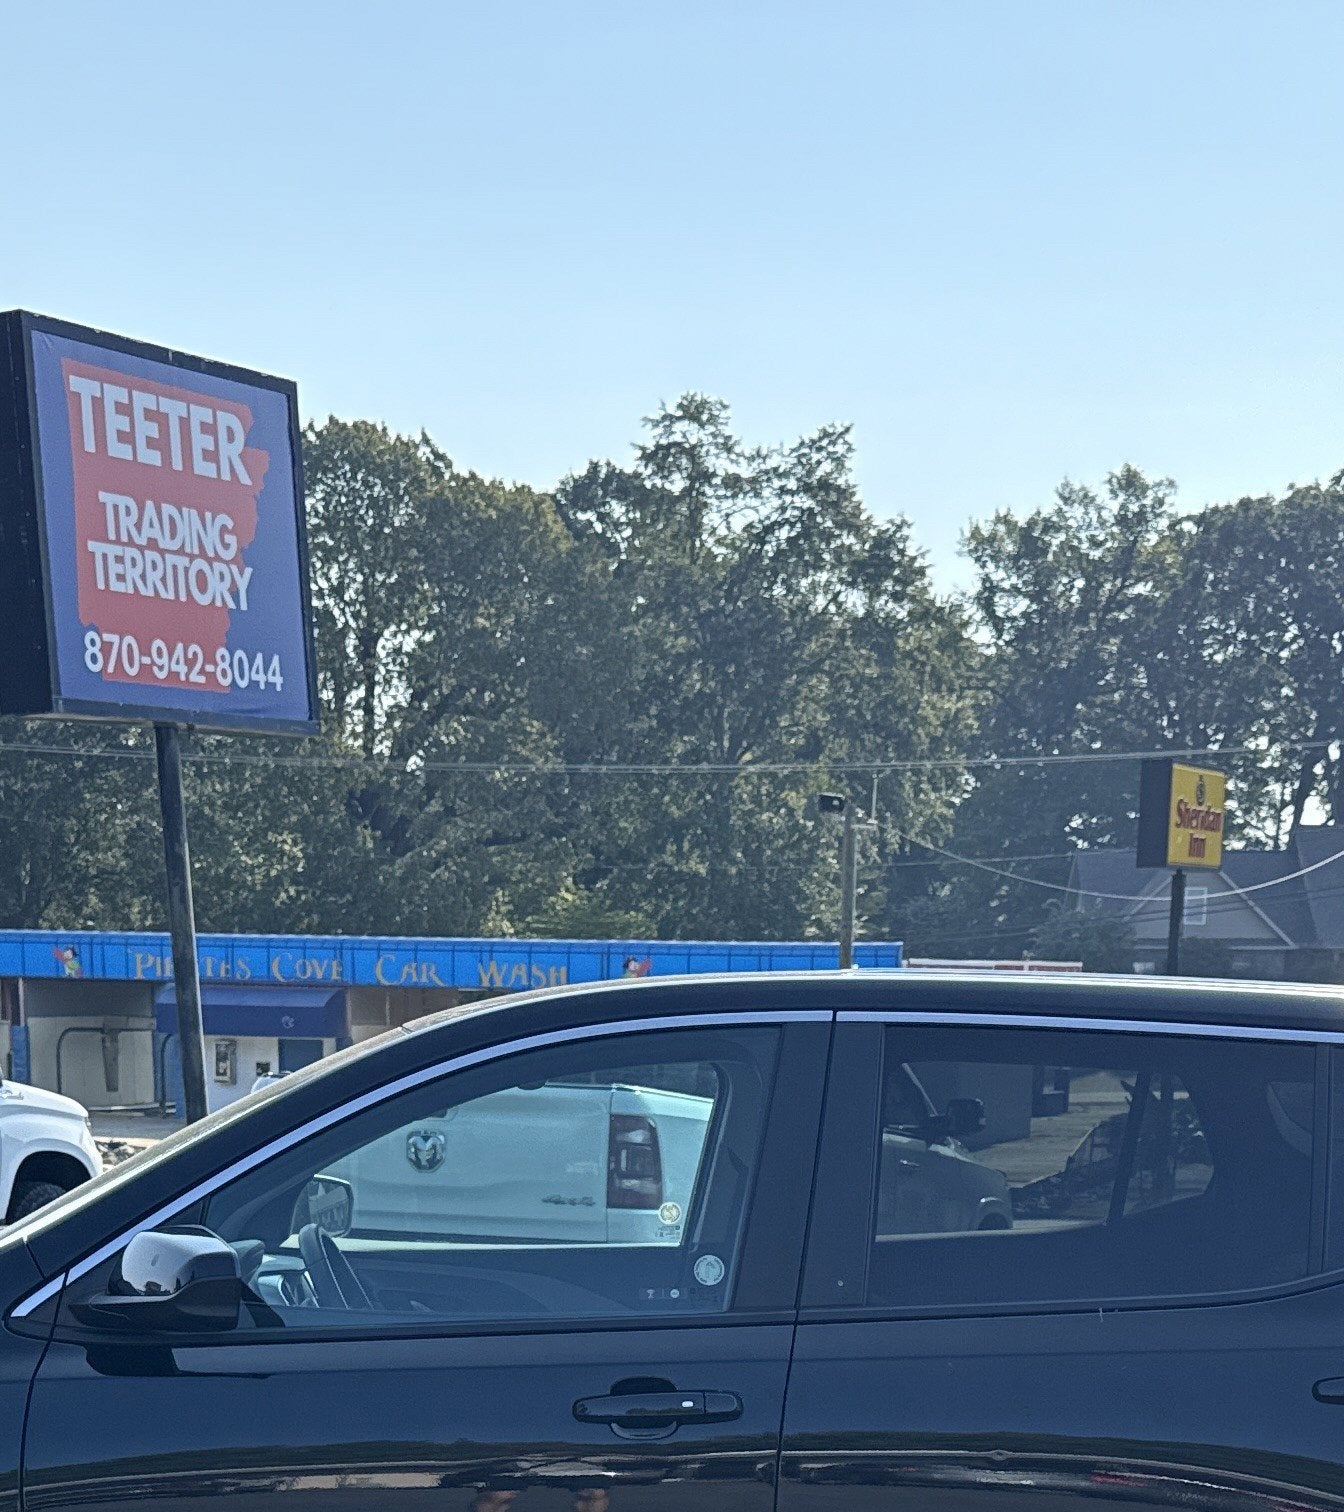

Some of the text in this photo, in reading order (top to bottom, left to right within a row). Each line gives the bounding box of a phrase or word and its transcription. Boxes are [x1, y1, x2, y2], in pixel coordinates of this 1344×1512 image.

[69, 374, 251, 486] TEETER
[98, 490, 238, 561] TRADING
[87, 540, 254, 611] TERRITORY
[84, 630, 284, 692] 870-942-8044
